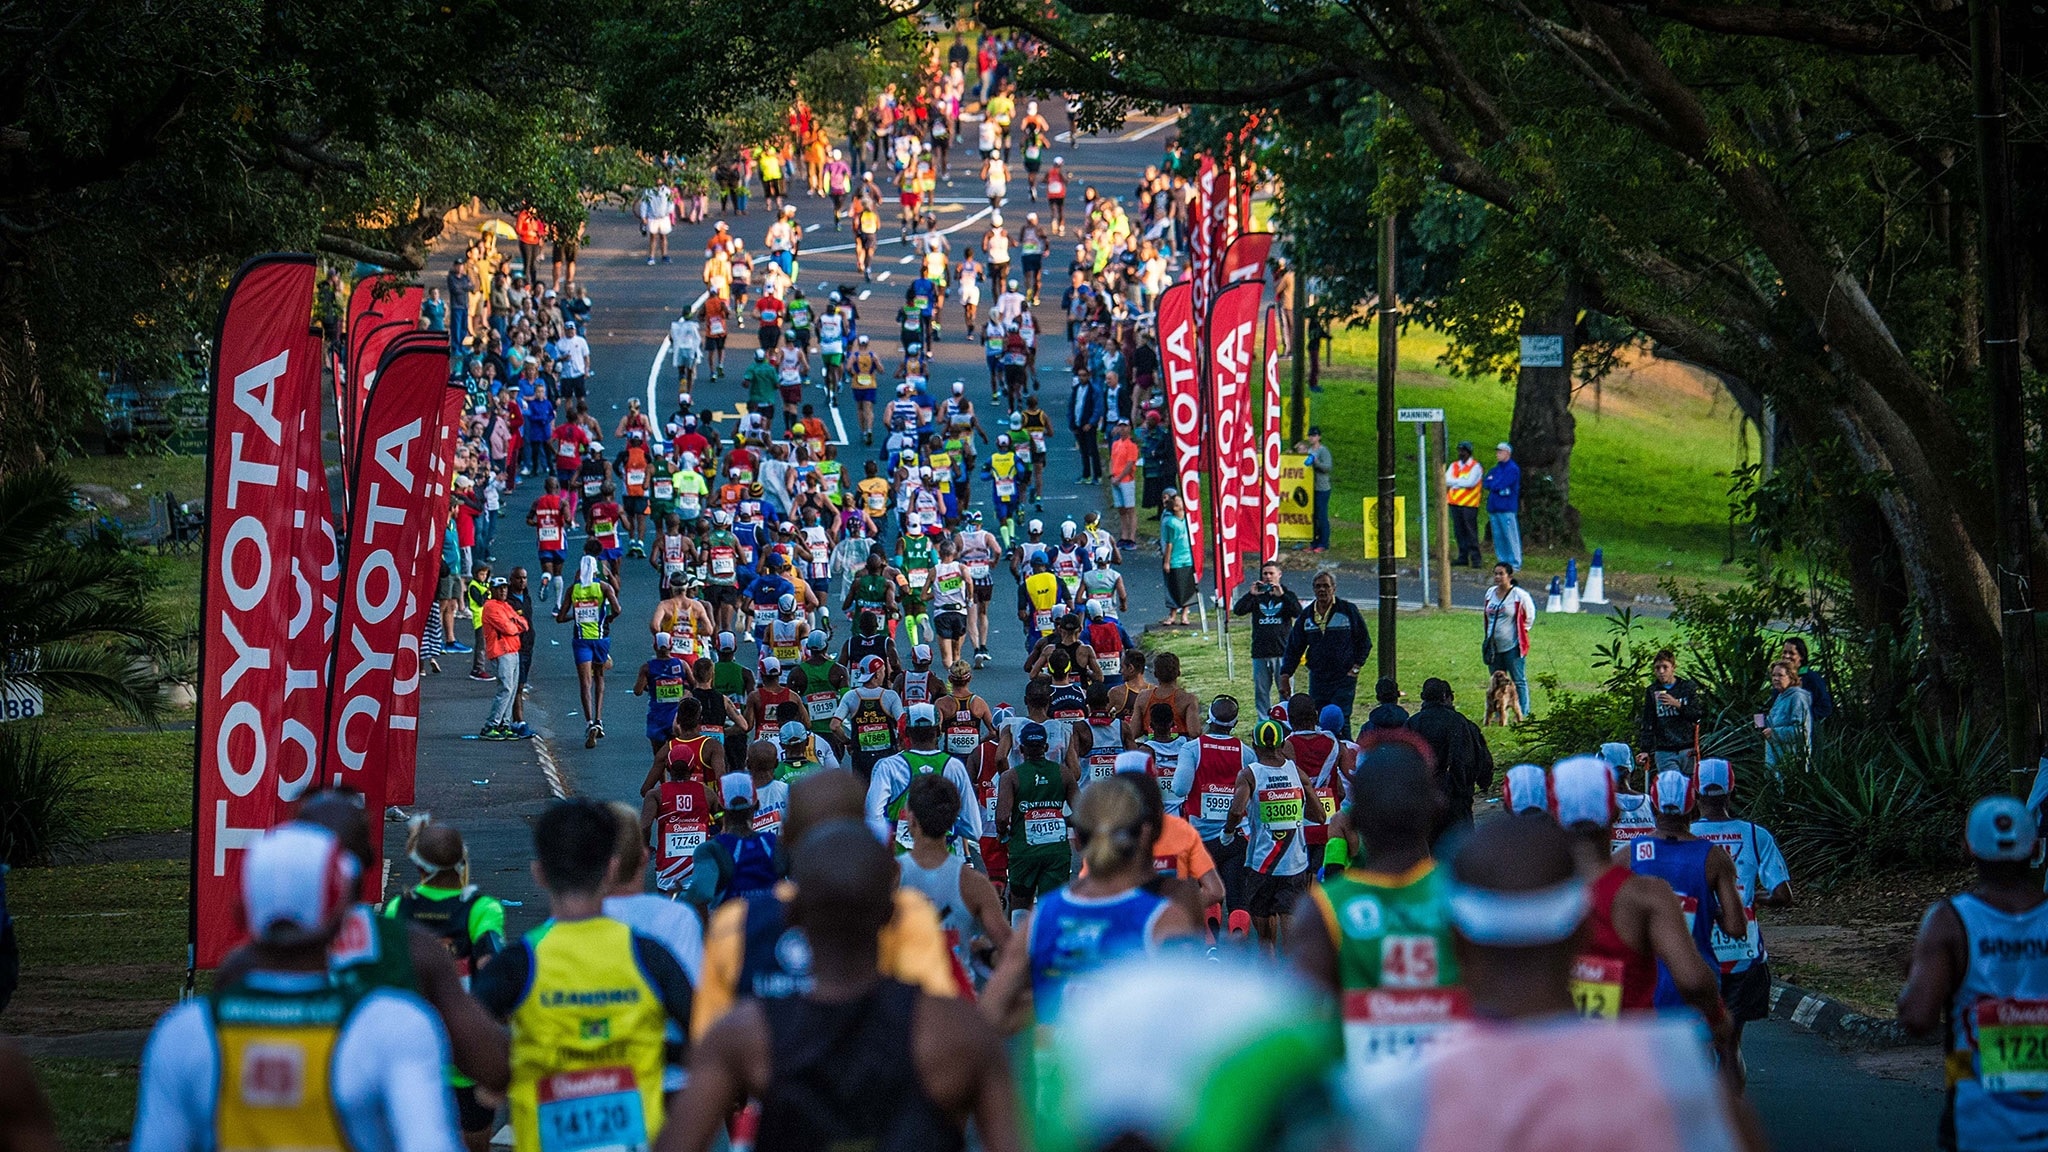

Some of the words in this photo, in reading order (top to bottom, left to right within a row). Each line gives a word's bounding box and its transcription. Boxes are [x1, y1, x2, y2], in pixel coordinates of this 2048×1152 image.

[1400, 411, 1434, 420] MANNING
[1165, 319, 1201, 546] TOYOTA
[1215, 327, 1239, 579] TOYOTA
[212, 348, 290, 878] TOYOTA
[1258, 617, 1282, 625] adidas
[811, 702, 834, 712] 10139
[957, 711, 970, 721] 40
[1267, 775, 1288, 783] BENONI
[1265, 782, 1292, 790] HARRIERS
[1267, 791, 1295, 800] Bonitas
[677, 795, 691, 810] 30
[1031, 810, 1057, 819] Bonitas
[1265, 803, 1298, 817] 33080
[672, 824, 699, 832] Bonitas
[752, 815, 774, 829] onitas
[1030, 821, 1060, 834] 40180
[670, 835, 700, 847] 17748
[1639, 844, 1653, 859] 50
[1383, 943, 1436, 977] 45
[553, 1104, 628, 1137] 14120
